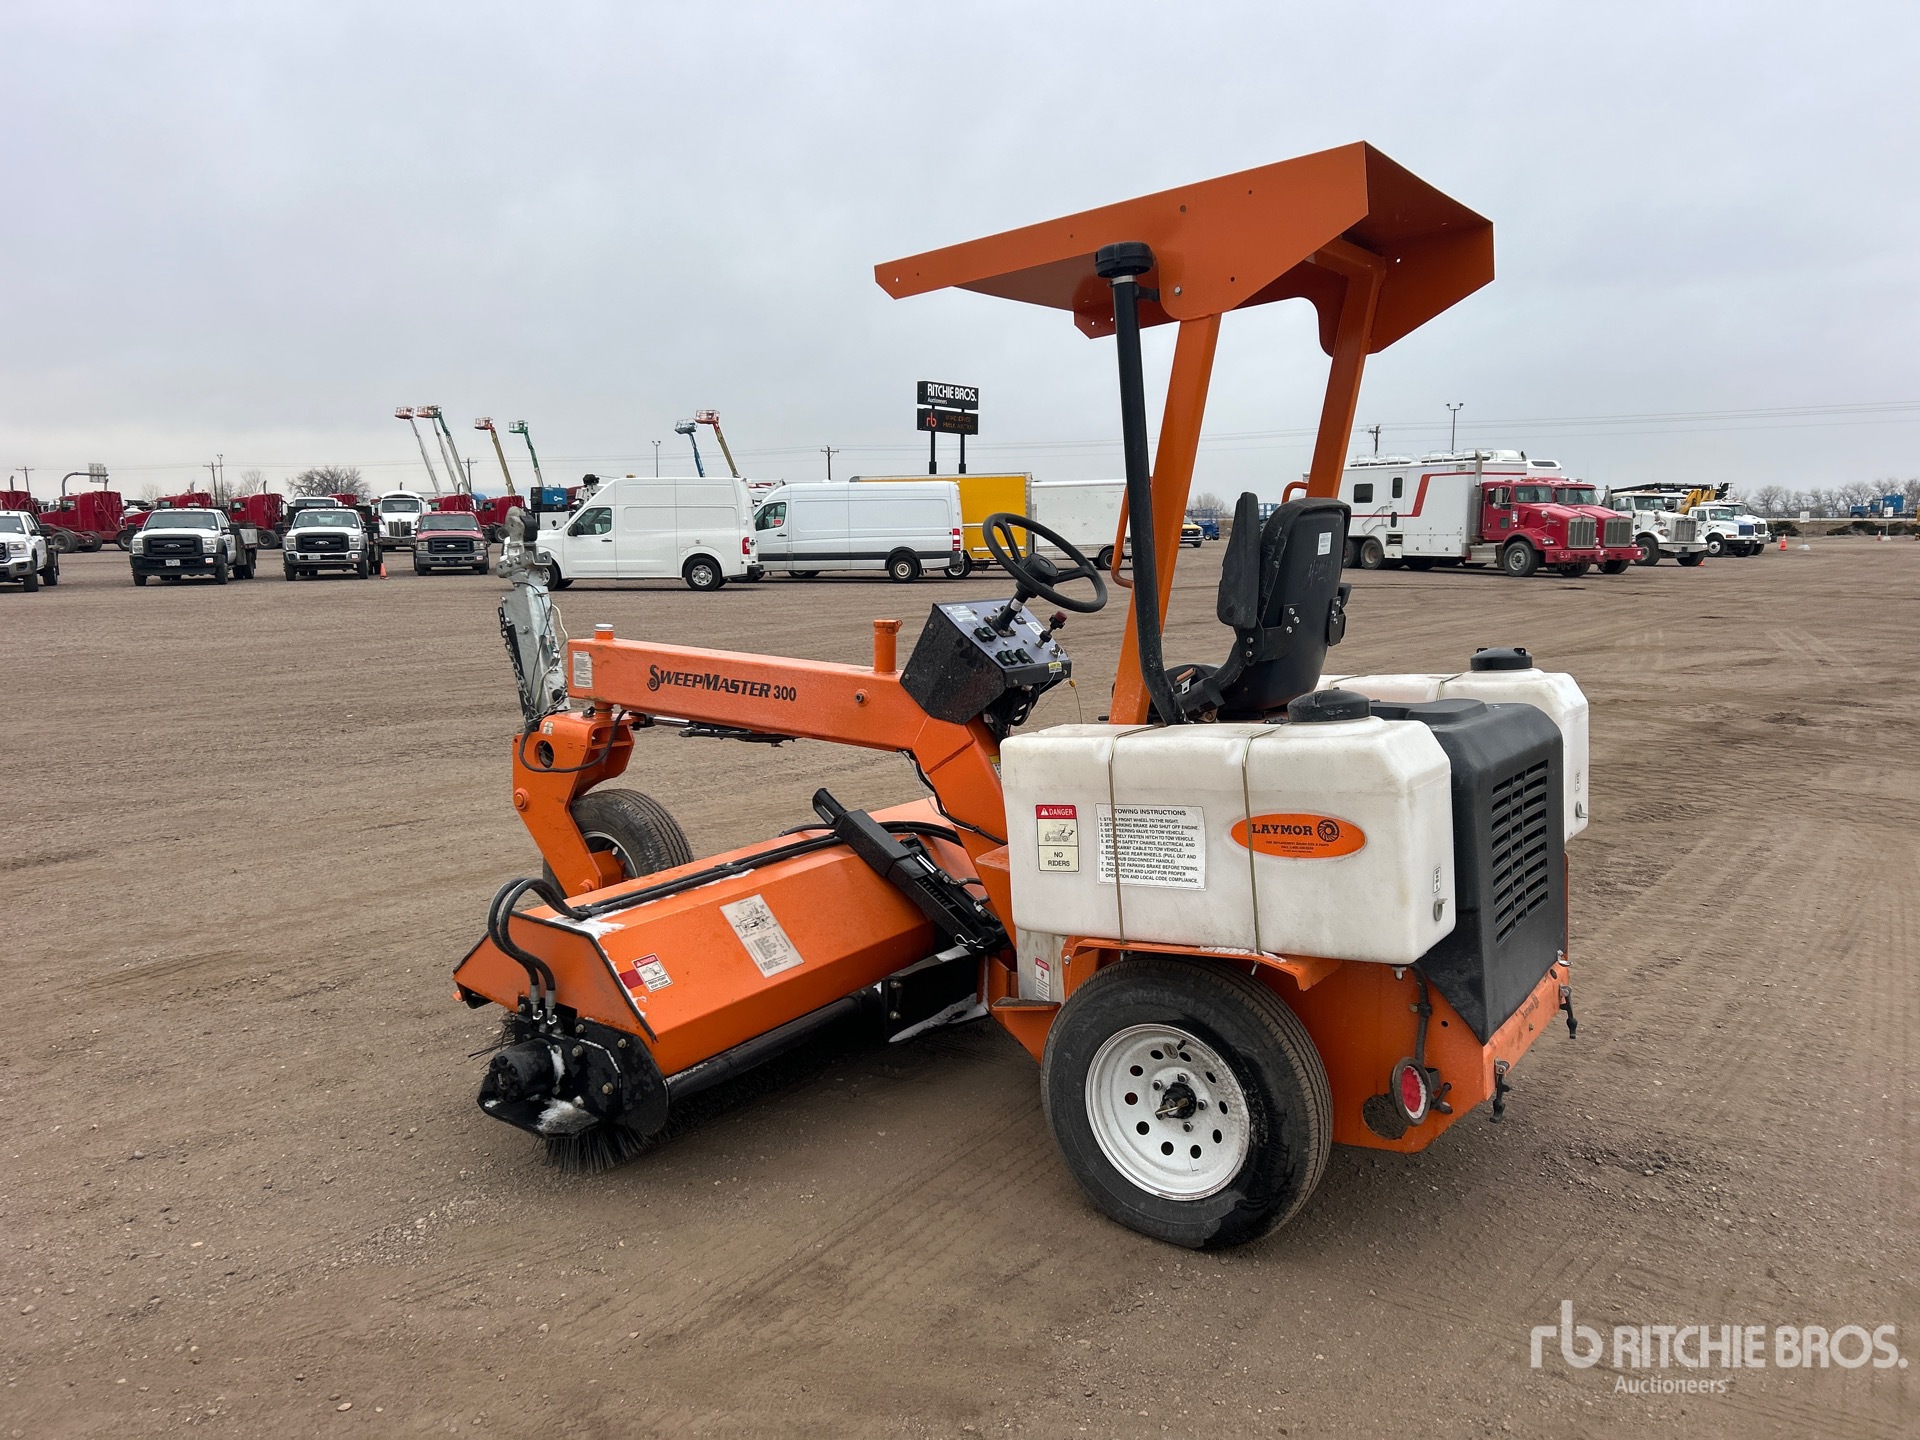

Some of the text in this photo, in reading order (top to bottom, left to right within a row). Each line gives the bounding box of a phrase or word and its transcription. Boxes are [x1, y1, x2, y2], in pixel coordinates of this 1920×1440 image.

[927, 383, 977, 401] RITCHIE BROS.
[926, 411, 937, 428] rb
[773, 684, 797, 702] 300
[1049, 808, 1074, 816] DANGER
[1252, 823, 1314, 836] LAYMOR
[1047, 859, 1071, 867] RIDERS
